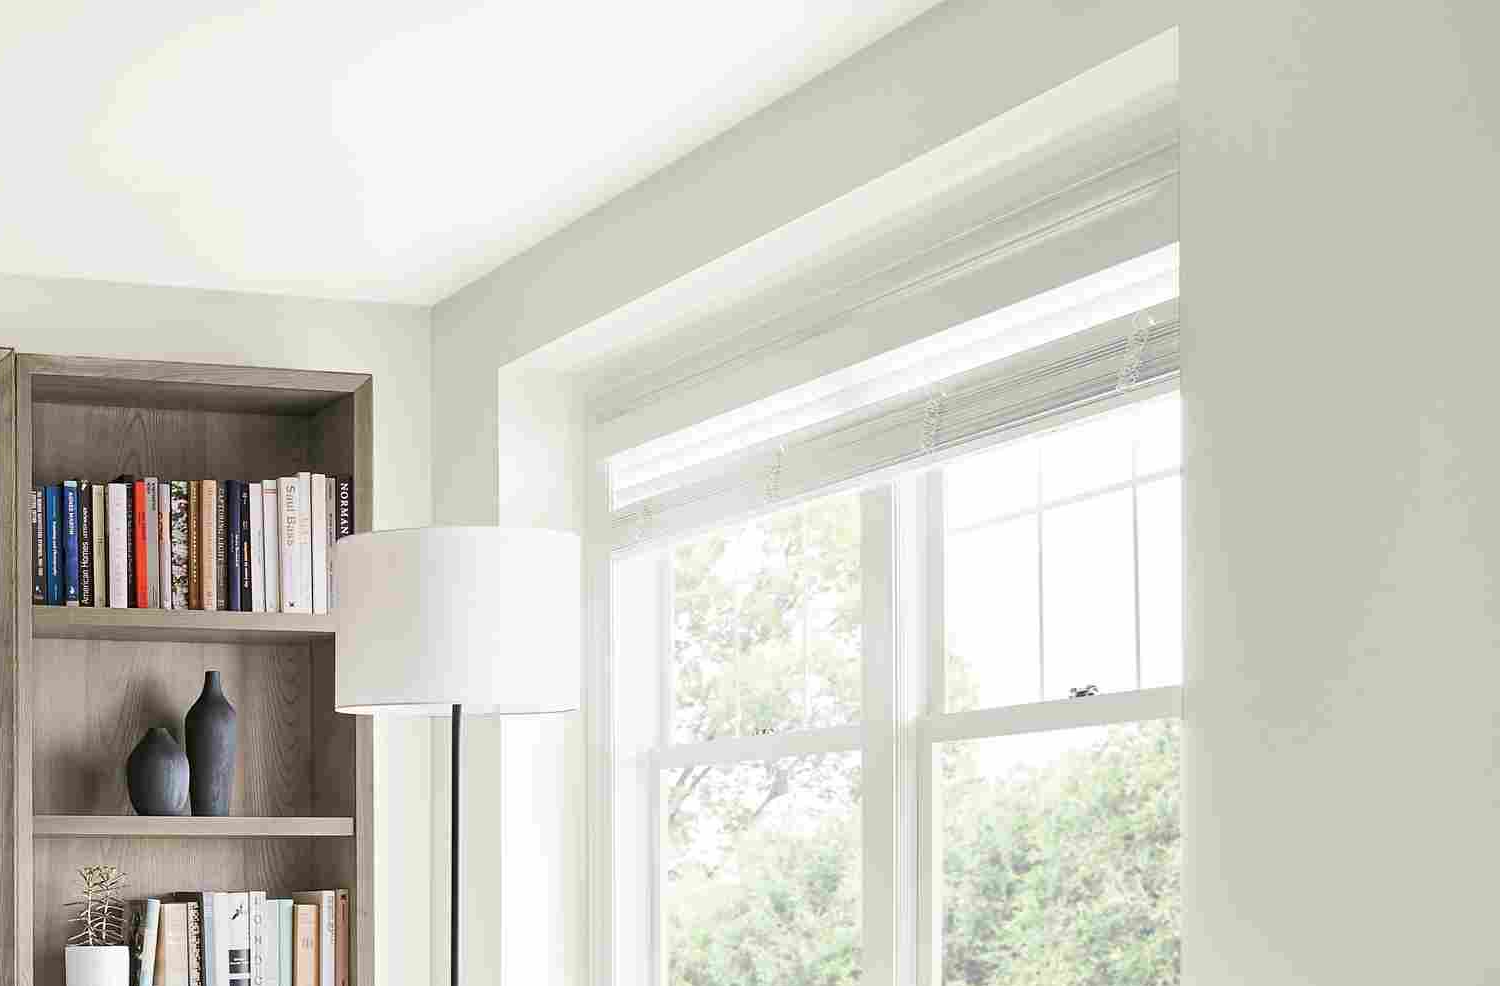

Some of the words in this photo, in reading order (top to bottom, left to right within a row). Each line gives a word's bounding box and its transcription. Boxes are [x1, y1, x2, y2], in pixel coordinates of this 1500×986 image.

[286, 485, 297, 513] Saul
[340, 482, 349, 534] NORMAN
[81, 542, 89, 568] Homes
[81, 569, 89, 604] American
